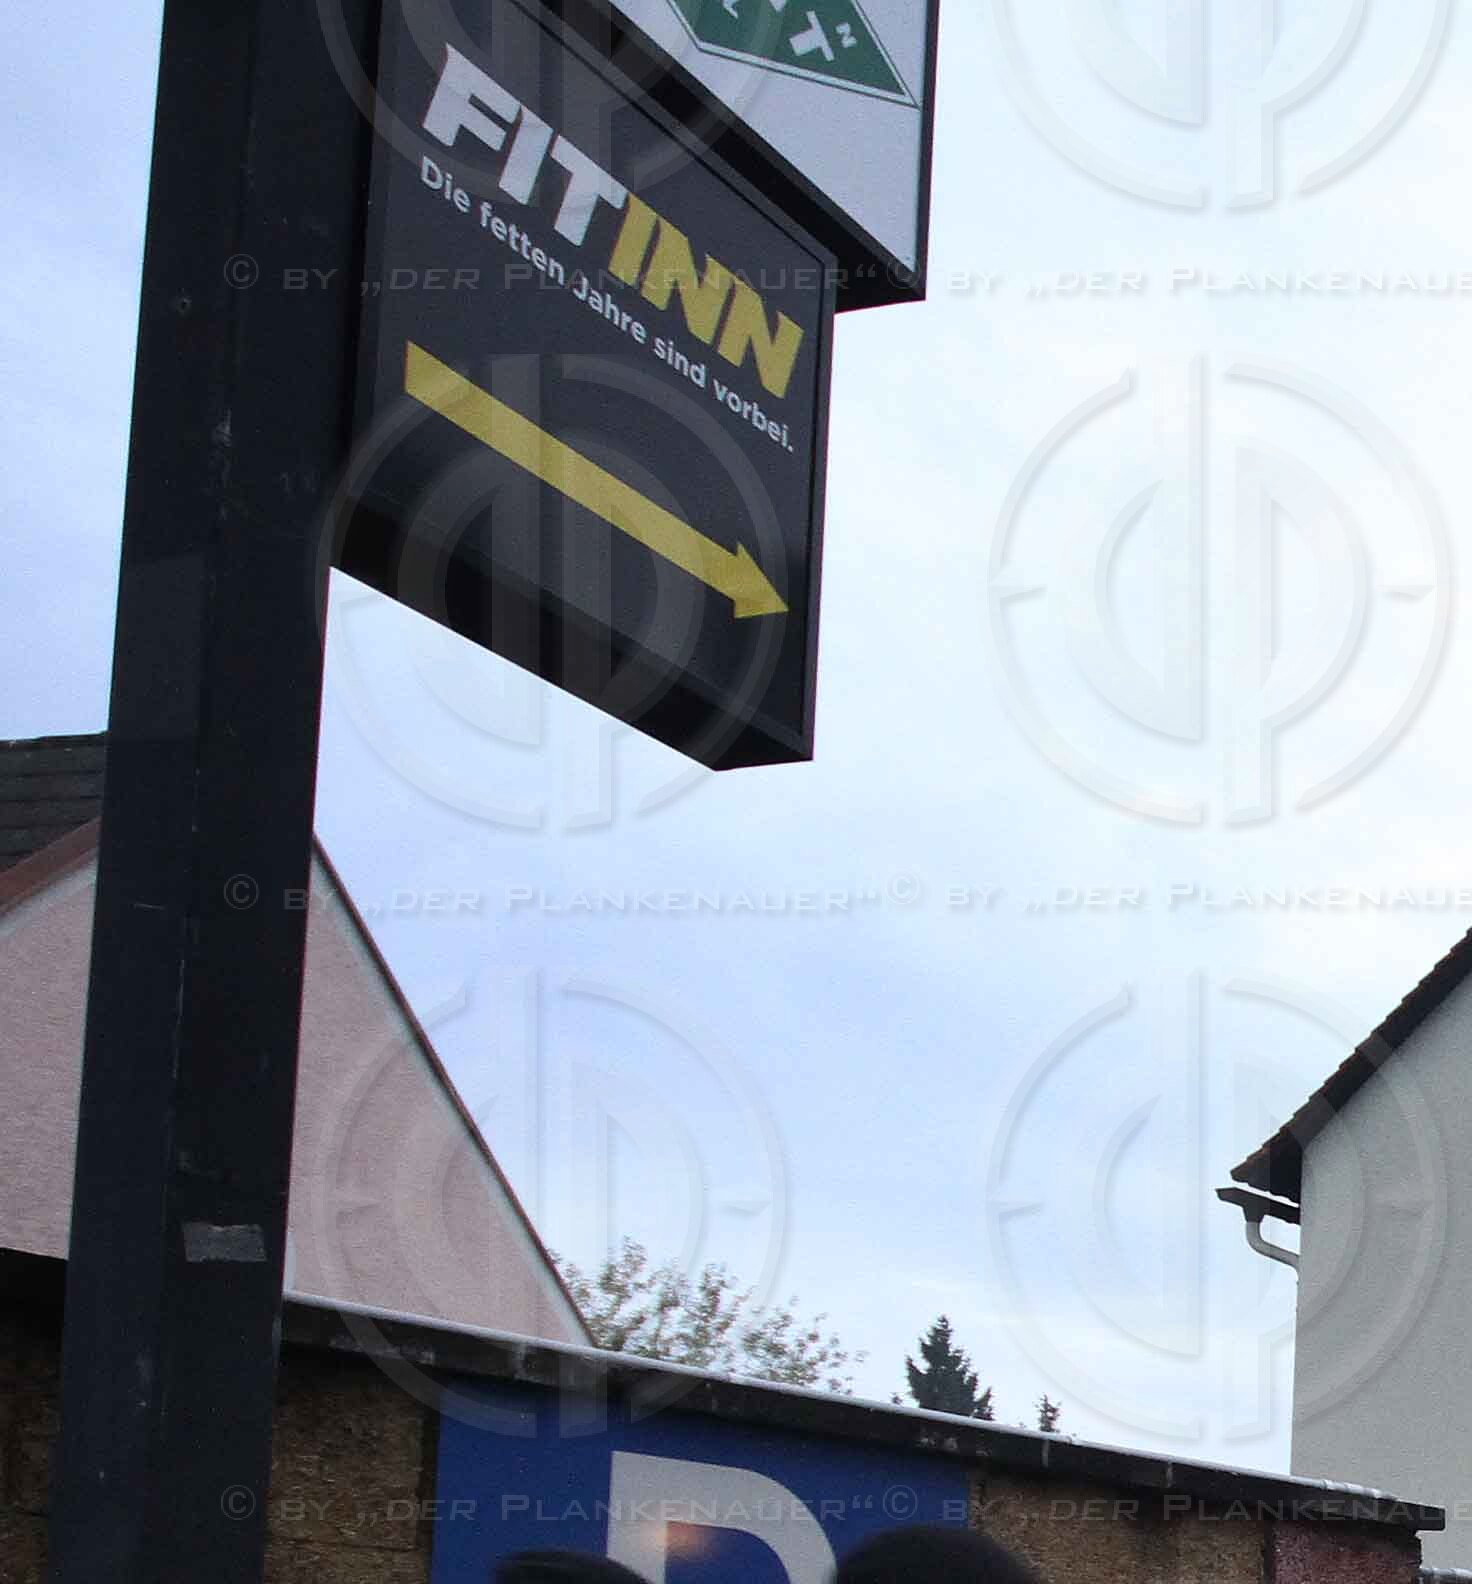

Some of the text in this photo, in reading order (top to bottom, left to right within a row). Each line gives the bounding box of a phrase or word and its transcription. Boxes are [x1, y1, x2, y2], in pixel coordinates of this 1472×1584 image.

[420, 156, 795, 453] Die fetten Jahre sind vorbei.
[421, 41, 804, 398] FITINN
